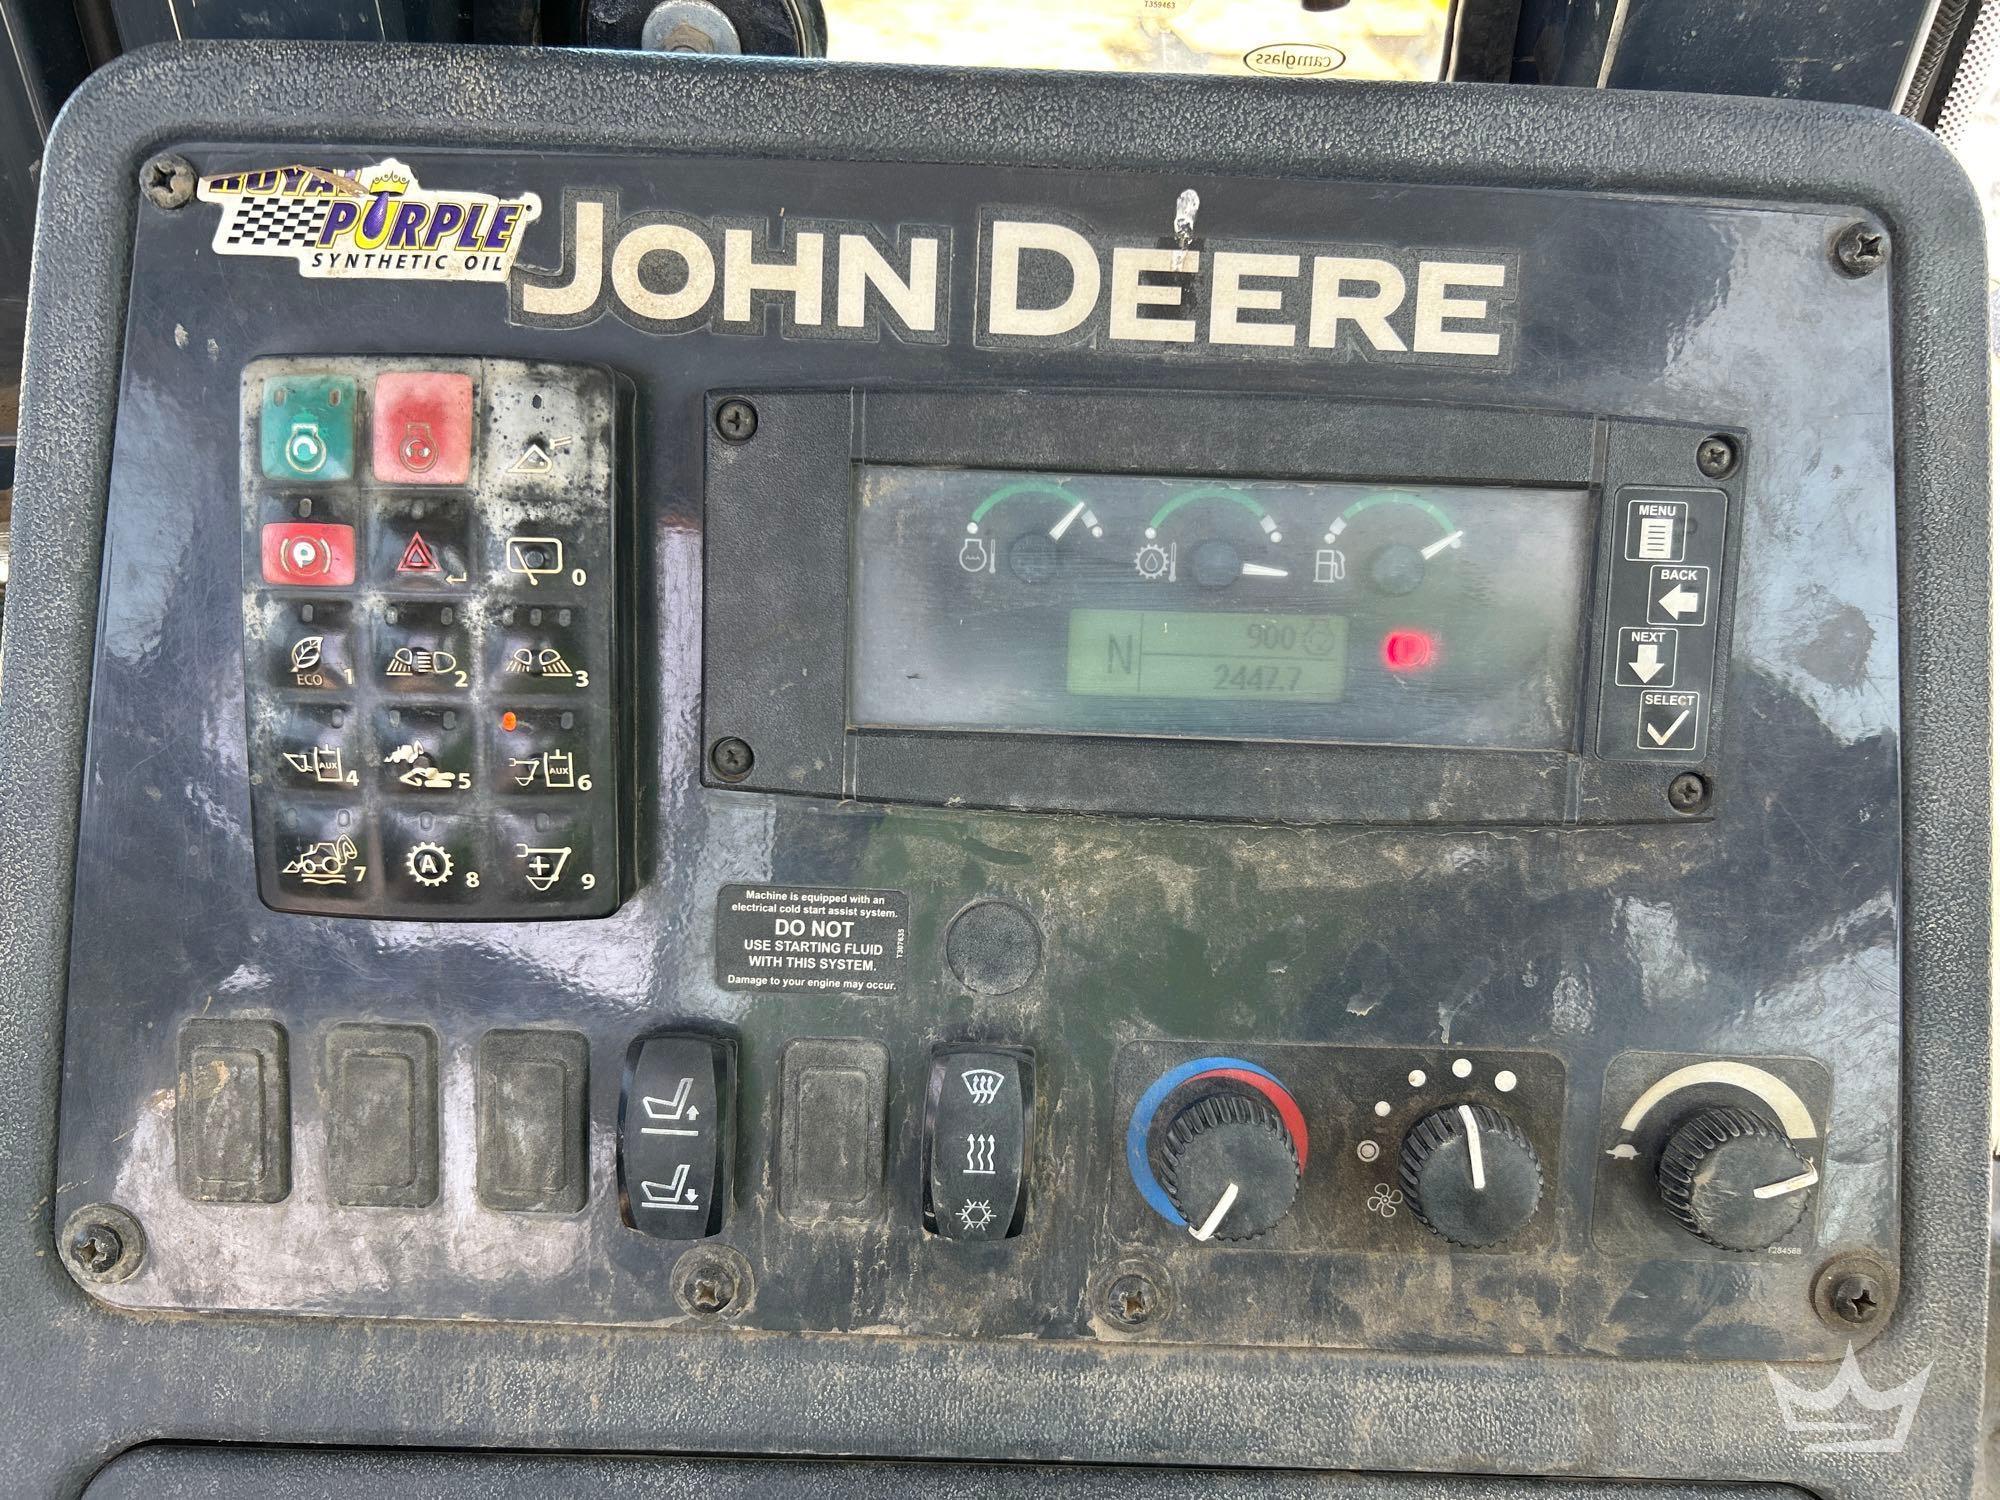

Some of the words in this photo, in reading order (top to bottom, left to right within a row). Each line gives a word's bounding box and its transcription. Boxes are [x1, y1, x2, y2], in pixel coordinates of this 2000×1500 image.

[316, 196, 525, 252] PURPLE
[311, 252, 449, 270] SYNTHETIC
[464, 255, 503, 271] OIL
[523, 200, 938, 332] JOHN
[987, 220, 1506, 356] DEERE
[1638, 504, 1677, 517] MENU
[571, 568, 587, 586] 0
[1660, 569, 1698, 581] BACK
[1246, 623, 1296, 651] 900
[1631, 631, 1666, 643] NEXT
[1106, 632, 1133, 674] N
[296, 673, 323, 686] ECO
[343, 668, 354, 685] 1
[454, 670, 468, 688] 2
[575, 670, 590, 688] 3
[1212, 662, 1304, 693] 2447.7
[1644, 694, 1695, 706] SELECT
[319, 761, 338, 770] AUX
[549, 767, 569, 775] AUX
[345, 769, 360, 787] 4
[458, 772, 472, 789] 5
[577, 774, 593, 791] 6
[420, 854, 438, 874] A
[353, 865, 367, 882] 7
[465, 871, 480, 888] 8
[580, 873, 596, 890] 9
[746, 890, 787, 901] Machine
[790, 892, 798, 901] is
[801, 893, 847, 905] equipped
[849, 894, 870, 904] with
[873, 897, 885, 905] an
[732, 903, 777, 913] electrical
[779, 905, 800, 914] cold
[803, 906, 825, 915] start
[828, 907, 857, 916] assist
[860, 909, 898, 918] system.
[775, 918, 805, 936] DO
[812, 920, 854, 938] NOT
[744, 939, 771, 951] USE
[775, 941, 840, 954] STARTING
[845, 943, 883, 956] FLUID
[749, 956, 782, 967] WITH
[786, 957, 816, 969] THIS
[820, 958, 877, 972] SYSTEM.
[728, 974, 767, 987] Damage
[770, 976, 780, 985] to
[783, 978, 805, 988] your
[808, 978, 840, 990] engine
[843, 981, 864, 991] may
[866, 982, 896, 990] occur.
